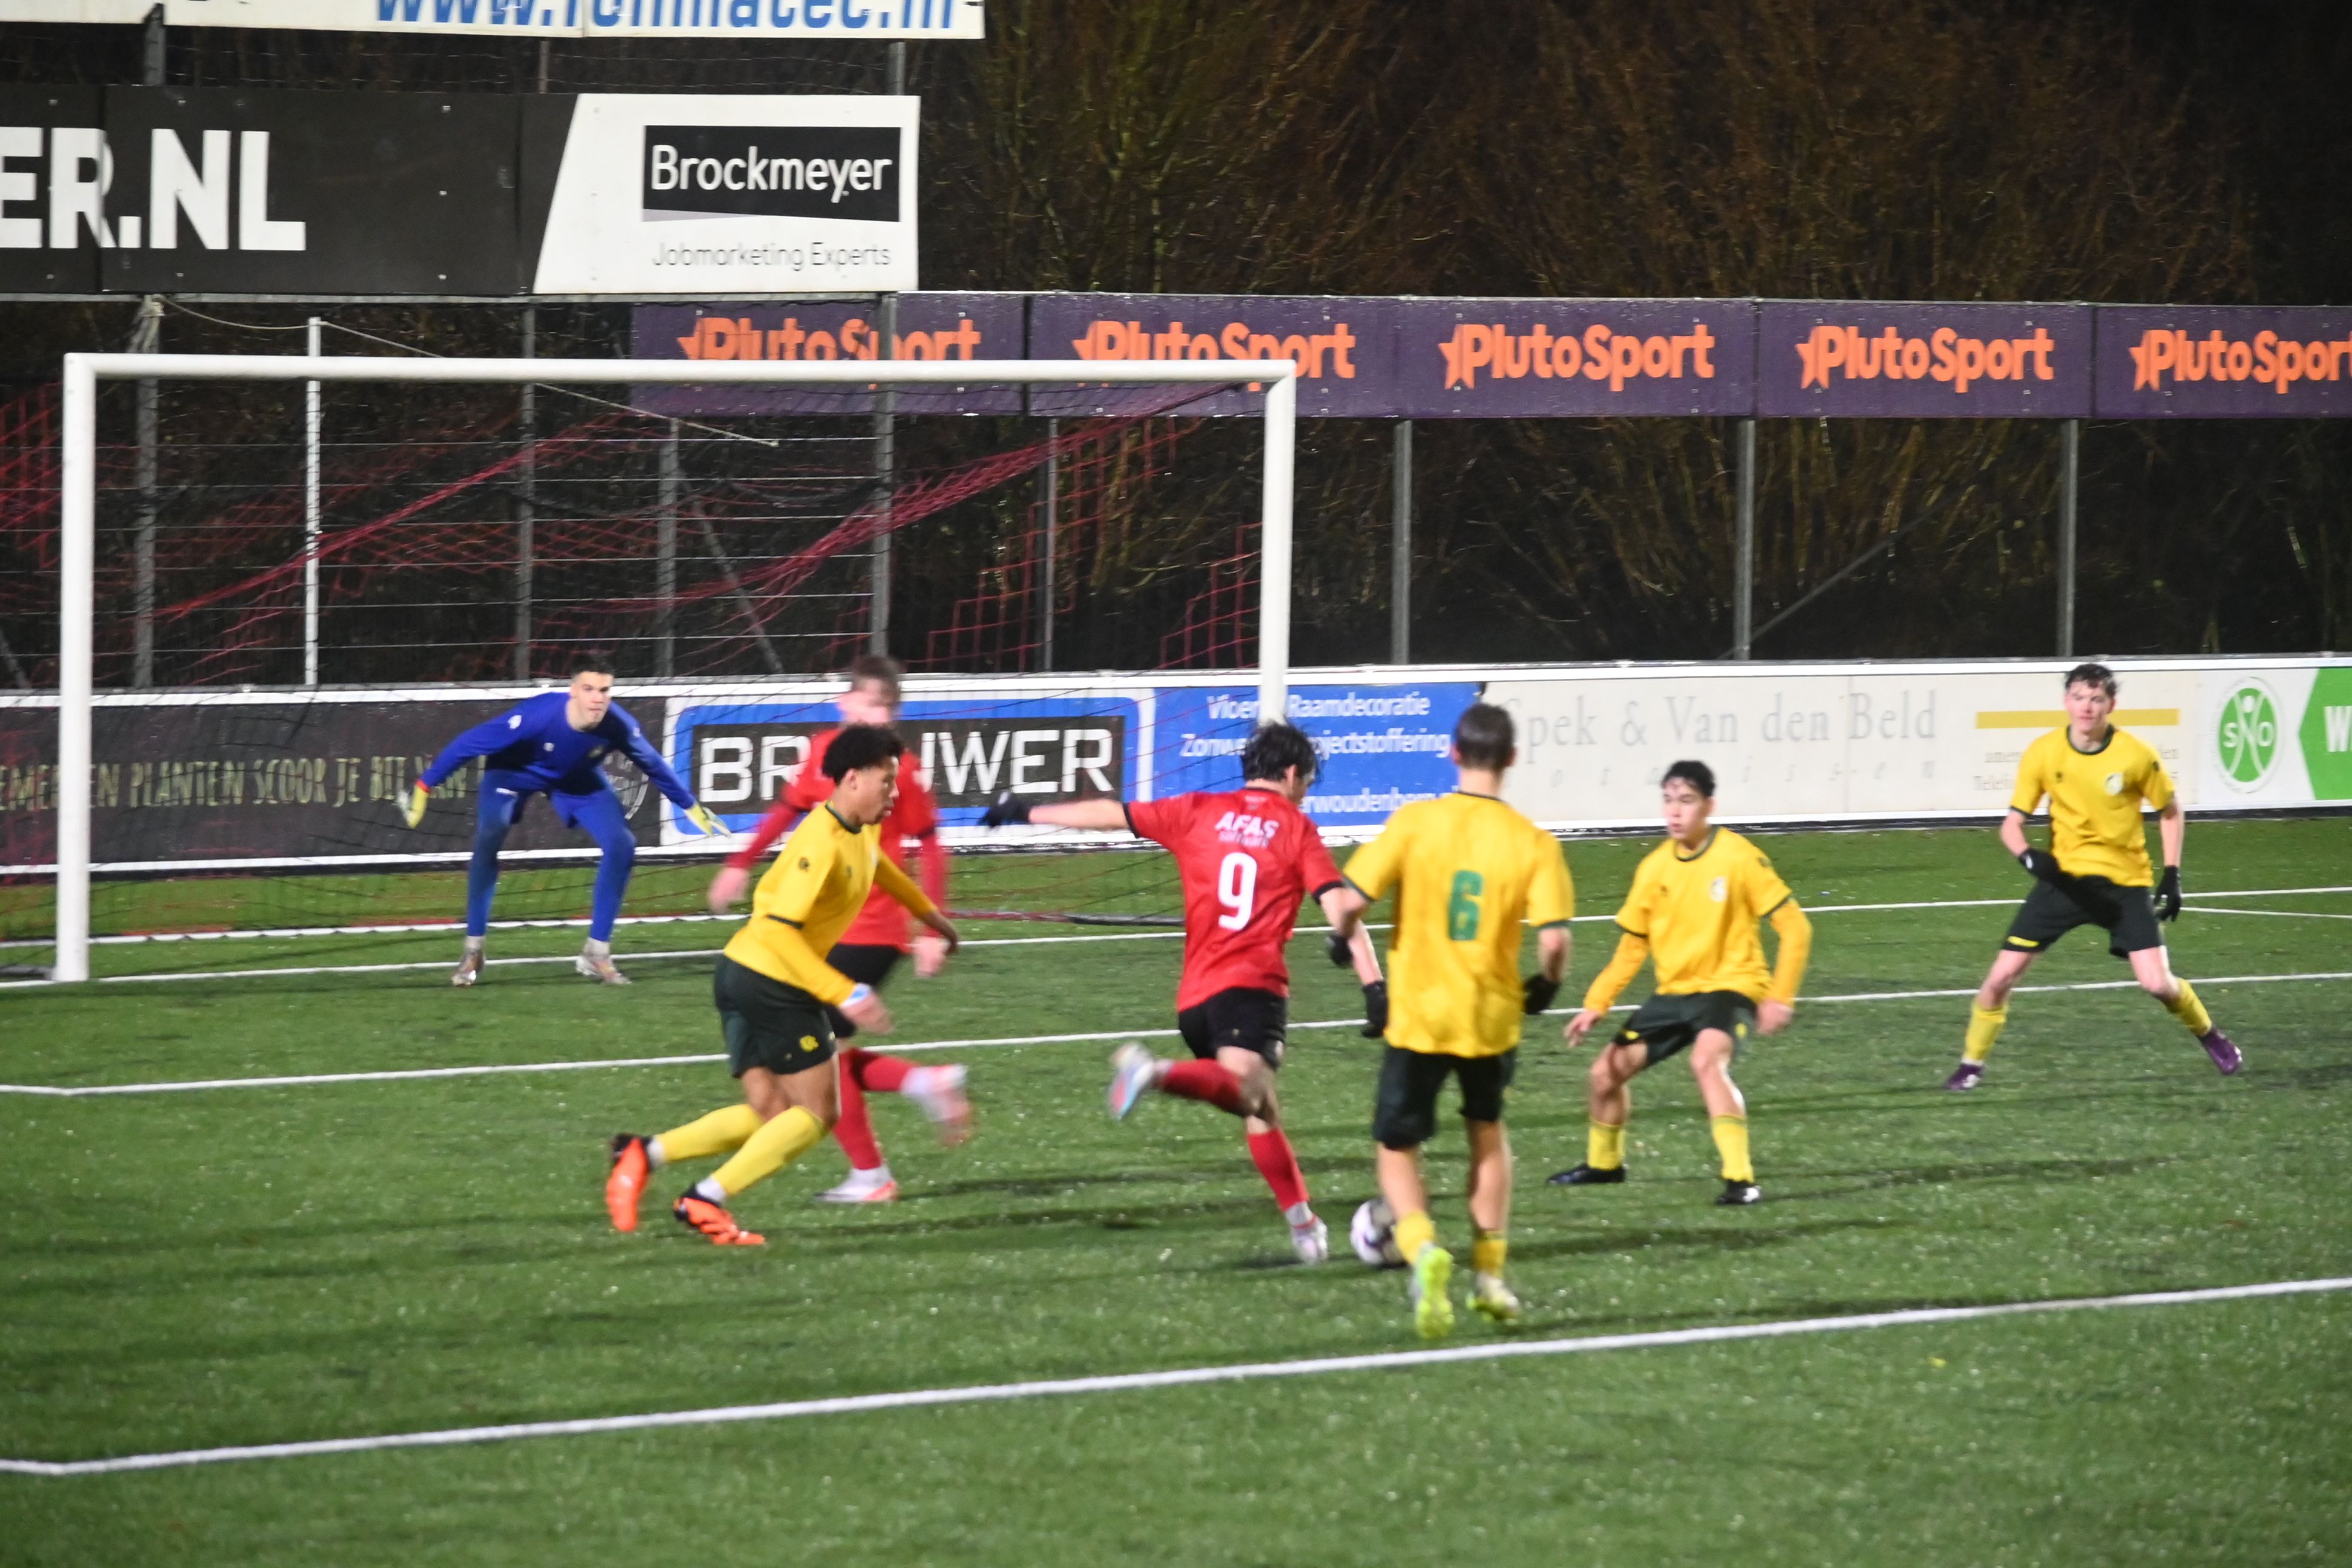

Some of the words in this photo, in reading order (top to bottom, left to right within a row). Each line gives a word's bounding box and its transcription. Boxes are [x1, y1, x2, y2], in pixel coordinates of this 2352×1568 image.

[0, 127, 306, 251] ER.NL
[651, 145, 893, 203] Brockmeyer
[653, 241, 804, 271] Jobmarketing
[811, 241, 893, 272] Experts
[1449, 324, 1714, 391] PlutoSport
[1809, 326, 2054, 393] PlutoSport
[2144, 329, 2352, 394] PlutoSpor
[1288, 691, 1431, 718] Raamdecoratie
[1620, 700, 1648, 746] &
[1665, 696, 1739, 743] Van
[1762, 691, 1830, 743] den
[1848, 688, 1937, 740] Beld
[130, 761, 244, 808] PLANTEN
[253, 757, 327, 805] SCOOR
[333, 757, 361, 808] JE
[699, 728, 1114, 802] BRWER
[1214, 811, 1280, 840] AFAS
[1218, 852, 1257, 930] 9
[1448, 870, 1483, 941] 6
